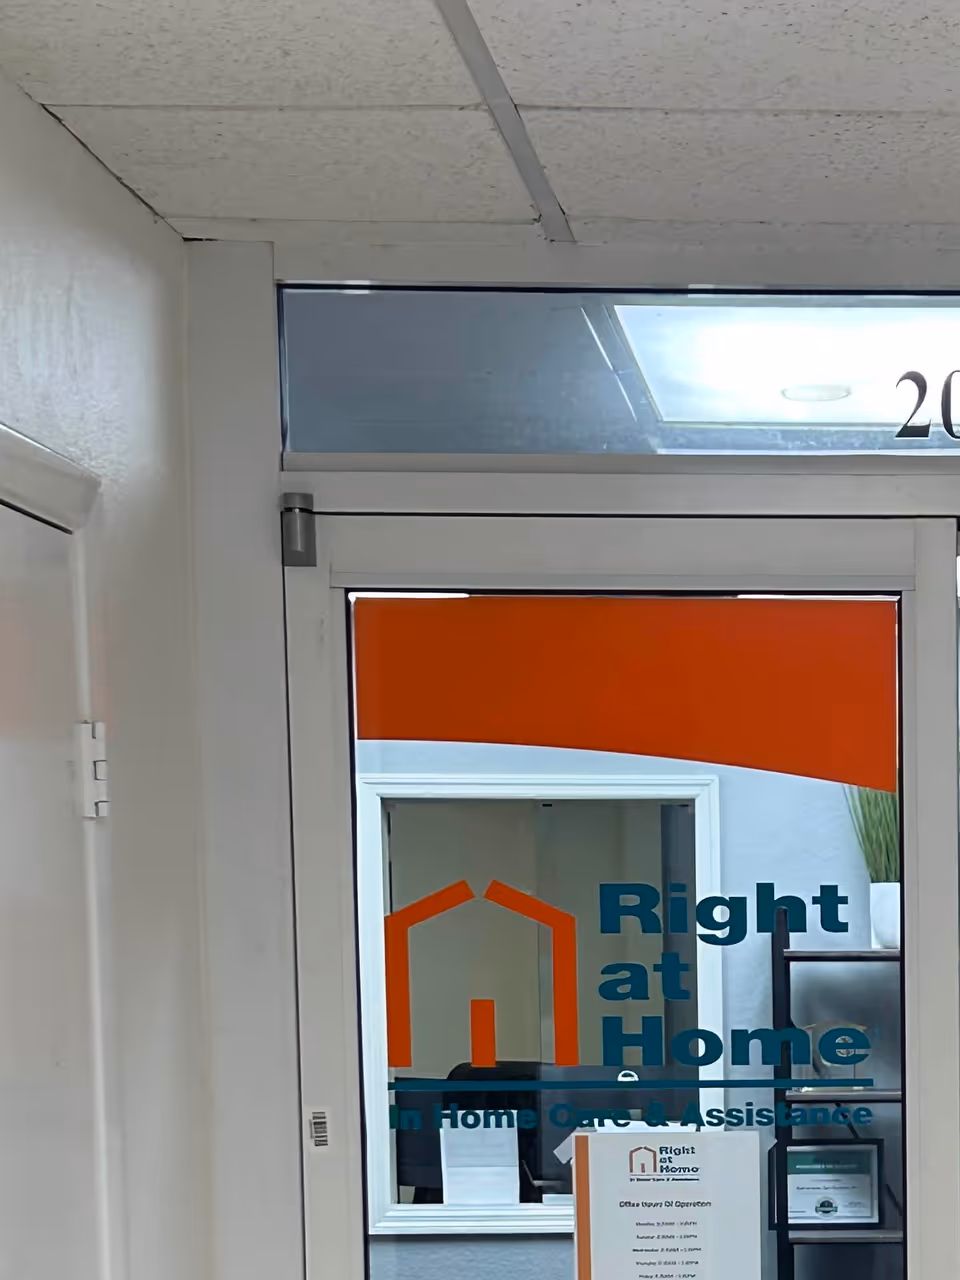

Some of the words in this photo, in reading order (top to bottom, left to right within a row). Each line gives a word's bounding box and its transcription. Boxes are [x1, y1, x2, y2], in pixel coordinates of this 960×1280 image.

[599, 882, 849, 946] Right
[598, 952, 691, 1001] at
[602, 1016, 872, 1066] Home
[388, 1104, 422, 1130] In
[440, 1103, 537, 1130] Home
[549, 1102, 634, 1129] Care
[643, 1101, 671, 1128] &
[680, 1101, 873, 1128] Assistance
